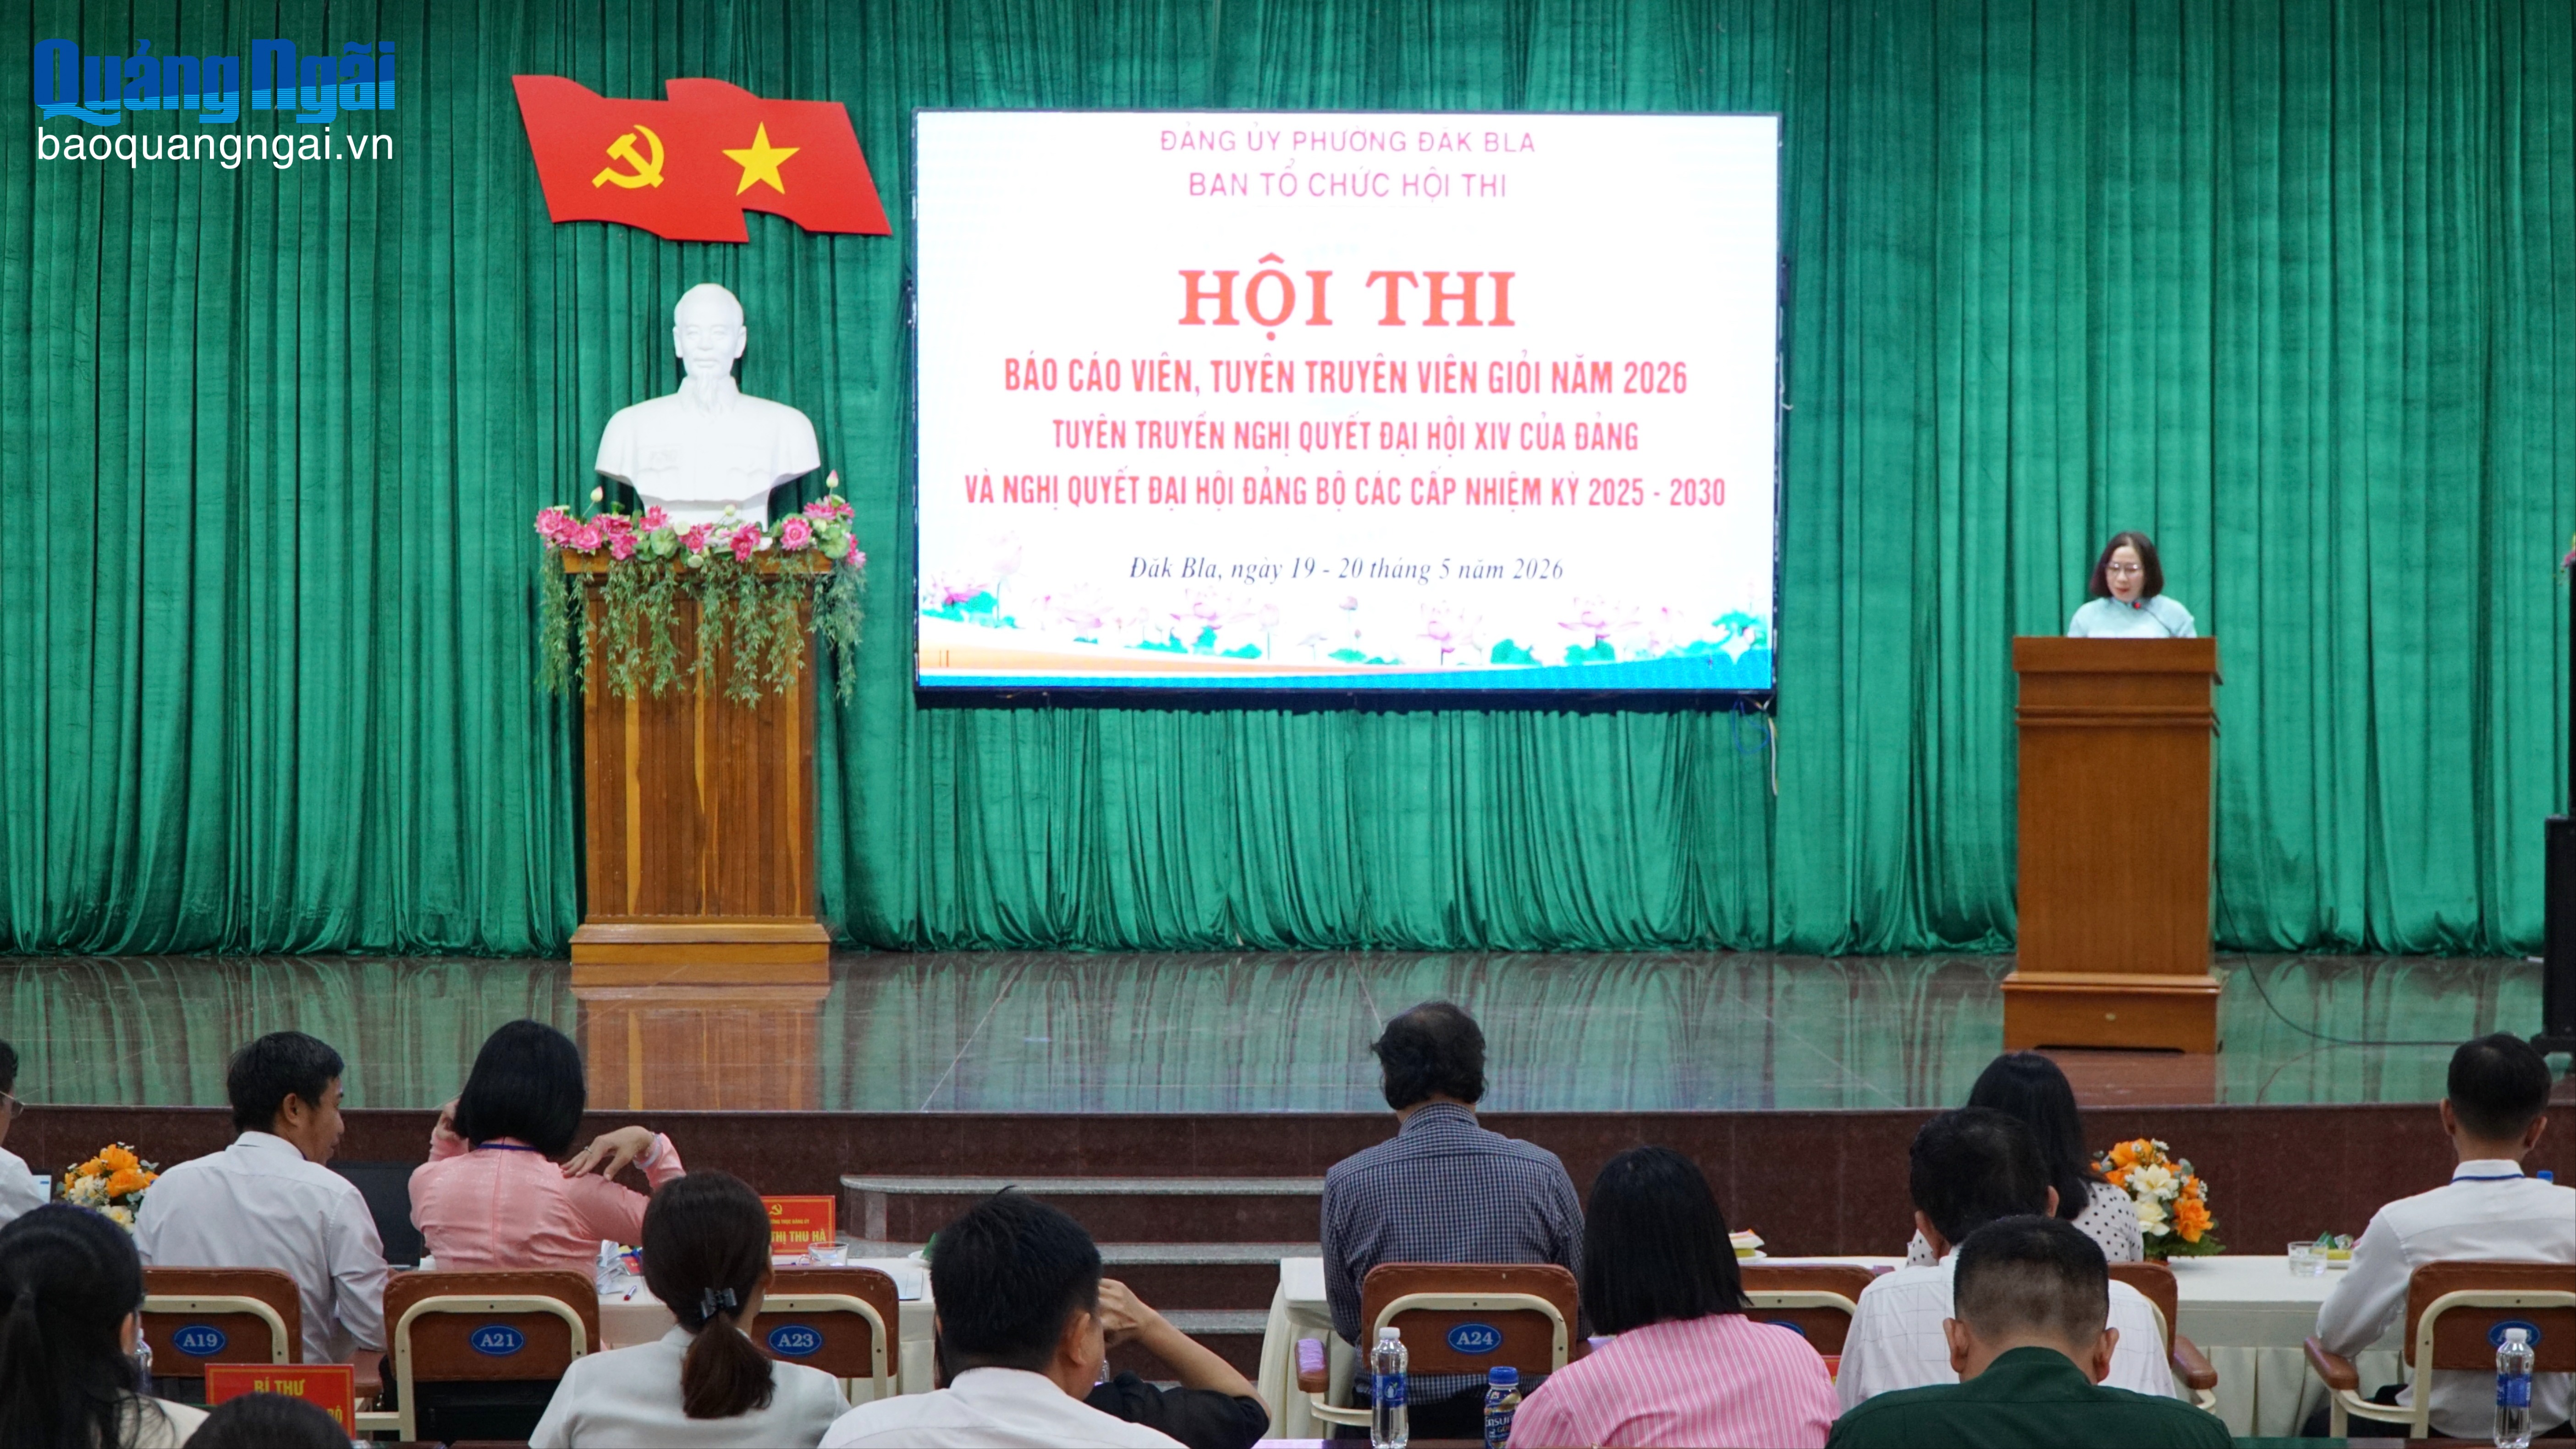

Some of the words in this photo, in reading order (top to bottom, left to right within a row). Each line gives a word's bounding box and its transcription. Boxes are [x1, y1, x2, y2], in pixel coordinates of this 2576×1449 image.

[1160, 121, 1236, 152] ĐẢNG
[1248, 121, 1281, 152] ỦY
[1293, 125, 1407, 152] PHƯỜNG
[1418, 126, 1472, 152] ĐĂK
[1484, 131, 1535, 152] BLA
[1189, 172, 1248, 197] BAN
[1260, 158, 1298, 198] TỔ
[1308, 165, 1390, 198] CHỨC
[1402, 166, 1449, 203] HỘI
[1461, 173, 1506, 197] THI
[1178, 252, 1333, 342] HỘI
[1365, 270, 1516, 327] THI
[1005, 350, 1058, 391] BÁO
[1068, 351, 1122, 392] CÁO
[1131, 351, 1200, 397] VIÊN,
[1210, 352, 1295, 394] TUYÊN
[1417, 353, 1478, 394] VIÊN
[1488, 349, 1541, 394] GIỎI
[1552, 354, 1613, 394] NĂM
[1623, 361, 1687, 394] 2026
[1052, 413, 1127, 449] TUYÊN
[1234, 421, 1290, 457] NGHỊ
[1299, 411, 1371, 453] QUYẾT
[1379, 421, 1418, 457] ĐẠI
[1427, 415, 1465, 457] HỘI
[1475, 422, 1511, 451] XIV
[1520, 412, 1566, 451] CỦA
[1574, 412, 1639, 451] ĐẢNG
[965, 468, 995, 504] VÀ
[1003, 474, 1059, 510] NGHỊ
[1068, 466, 1140, 507] QUYẾT
[1148, 476, 1187, 511] ĐẠI
[1196, 470, 1234, 511] HỘI
[1243, 466, 1307, 505] ĐẢNG
[1316, 470, 1346, 512] BỘ
[1355, 470, 1401, 506] CÁC
[1411, 466, 1457, 506] CẤP
[1466, 471, 1542, 512] NHIỆM
[1552, 470, 1580, 506] KỲ
[1588, 477, 1644, 507] 2025
[1670, 478, 1726, 507] 2030
[1129, 556, 1172, 578] Đăk
[1181, 556, 1222, 580] Bla,
[1231, 557, 1283, 585] ngày
[1292, 557, 1316, 579] 19
[1338, 557, 1364, 579] 20
[1370, 557, 1431, 584] tháng
[1439, 558, 1451, 579] 5
[1458, 558, 1504, 579] năm
[1513, 558, 1563, 579] 2026
[771, 1231, 787, 1245] THỊ
[789, 1230, 809, 1242] THU
[812, 1228, 826, 1242] HÀ
[183, 1333, 218, 1347] A19
[480, 1333, 515, 1347] A21
[777, 1333, 814, 1347] A23
[1456, 1331, 1494, 1345] A24
[254, 1376, 270, 1394] BÍ
[274, 1378, 306, 1396] THƯ
